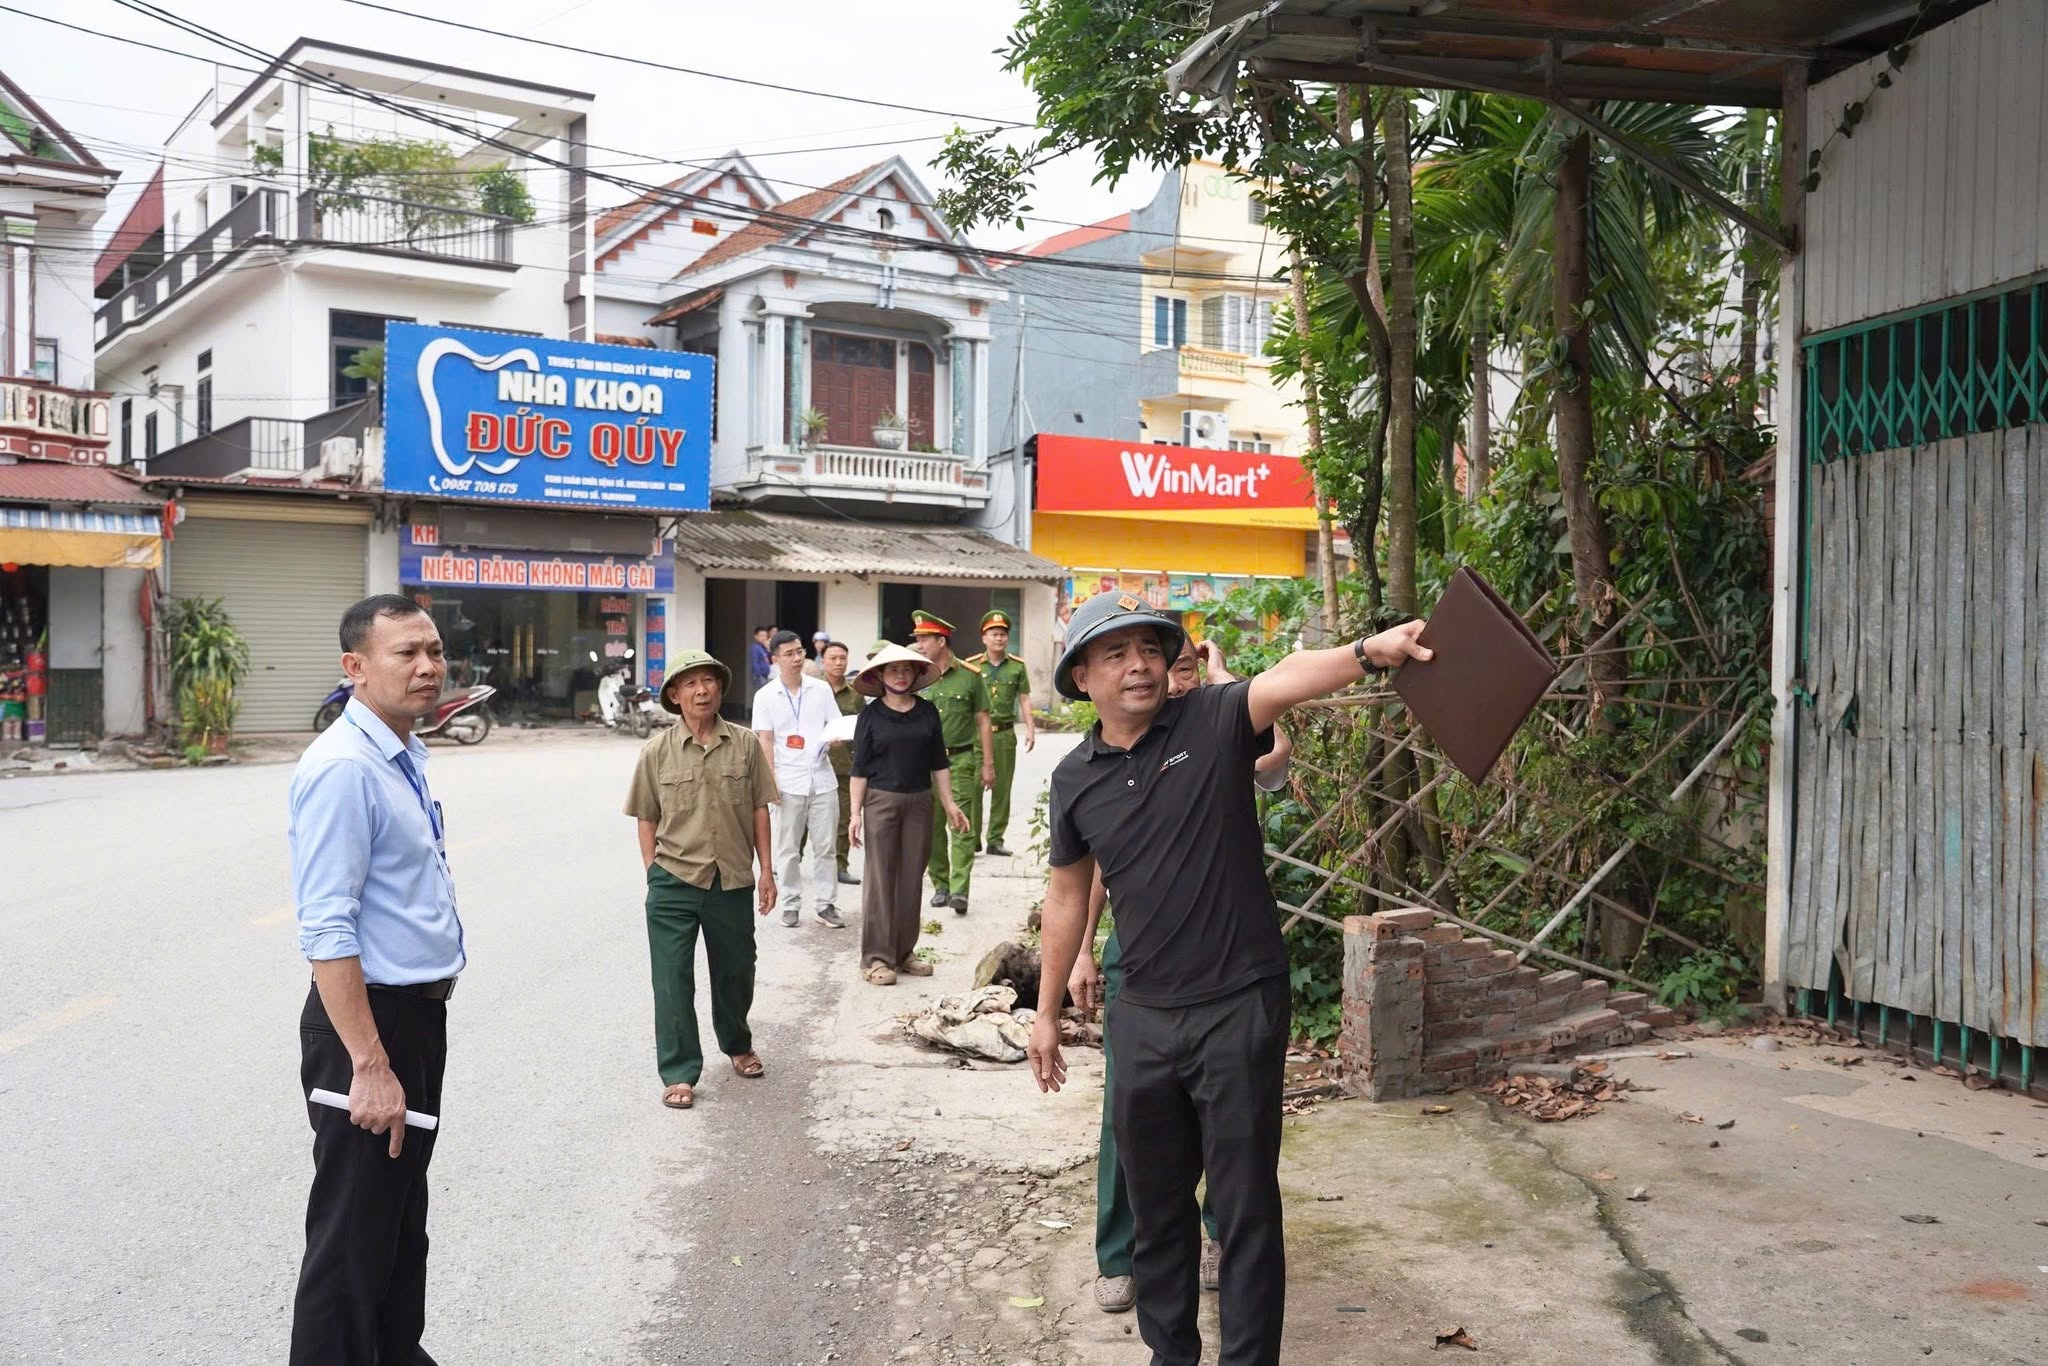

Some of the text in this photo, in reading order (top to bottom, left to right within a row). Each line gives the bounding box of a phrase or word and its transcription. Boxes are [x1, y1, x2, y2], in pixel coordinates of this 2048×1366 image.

[498, 369, 663, 414] NHA KHOA
[465, 406, 687, 467] ĐỨC QÚY
[479, 554, 527, 585] RĂNG
[529, 558, 586, 587] KHÔNG
